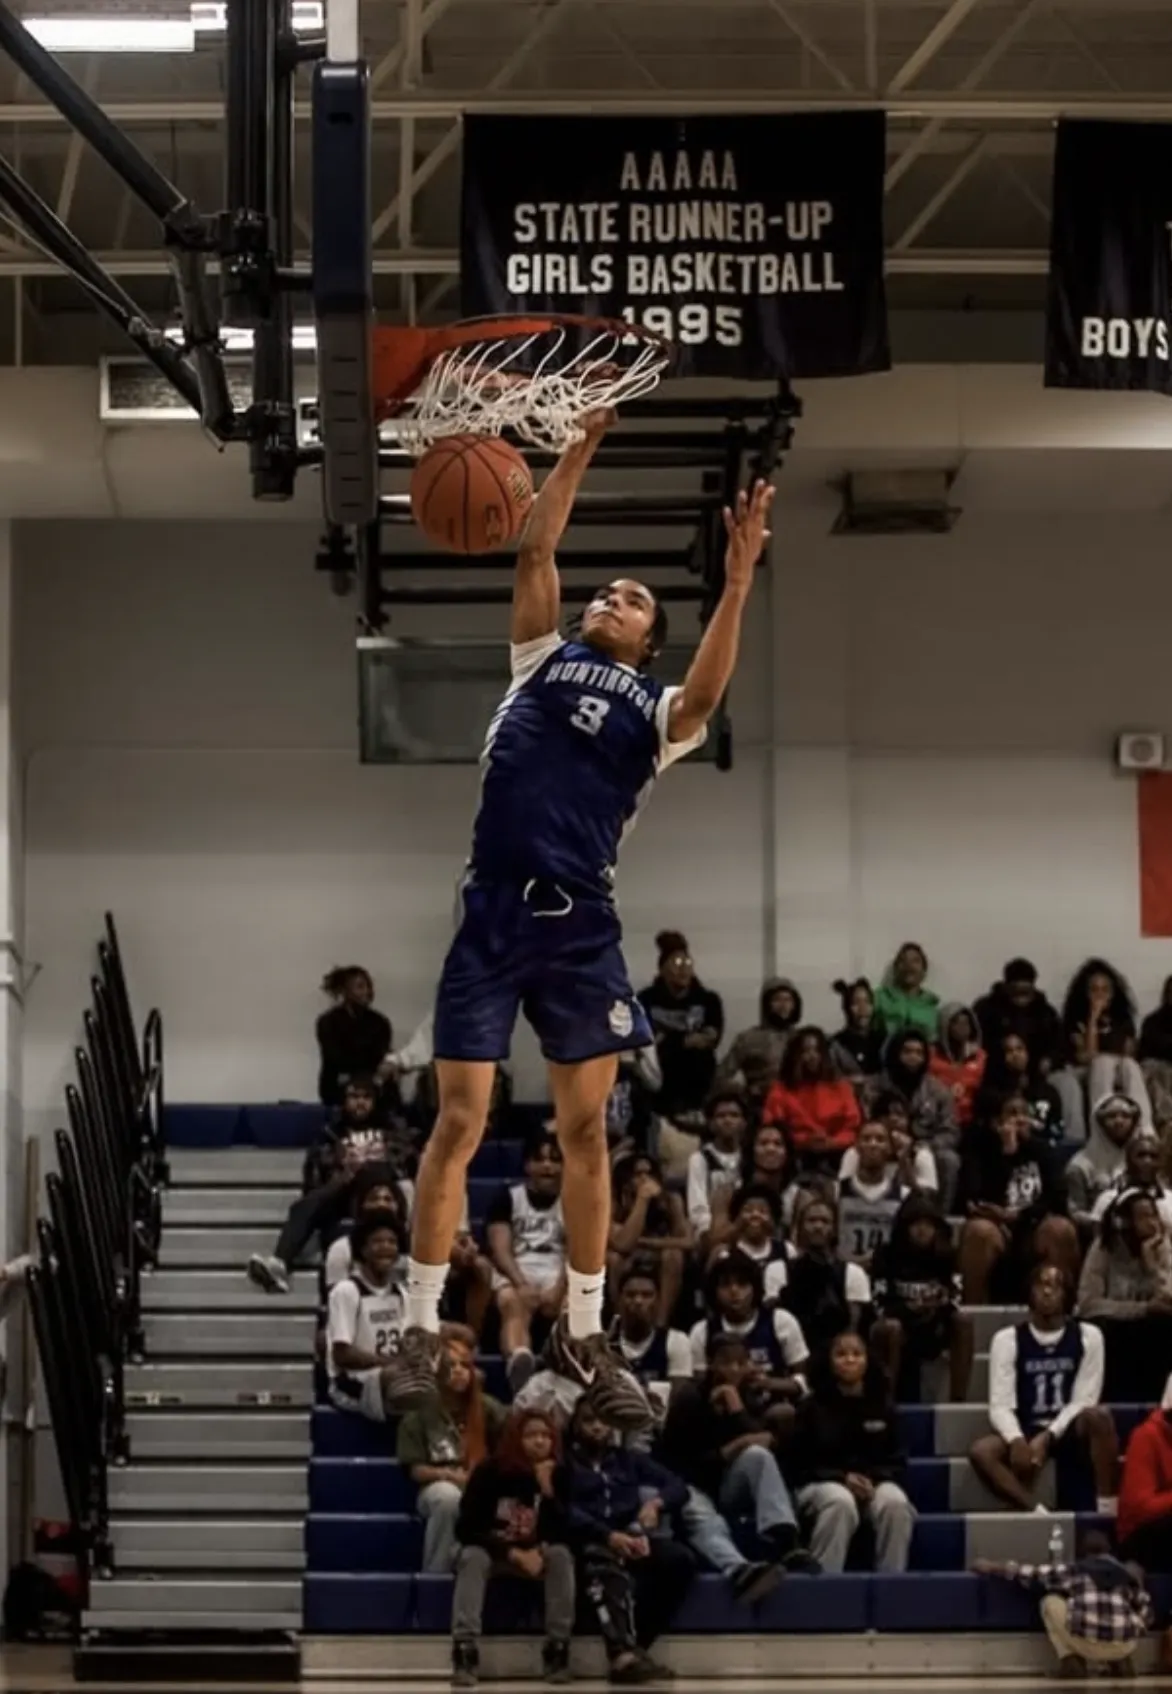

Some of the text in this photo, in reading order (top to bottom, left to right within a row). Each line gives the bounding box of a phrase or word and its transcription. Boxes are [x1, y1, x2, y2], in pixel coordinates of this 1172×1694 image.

[514, 201, 833, 243] STATE RUNNER-UP
[507, 252, 844, 295] GIRLS BASKETBALL
[1081, 316, 1169, 360] BOYS
[569, 695, 611, 735] 3
[1031, 1373, 1064, 1412] 11
